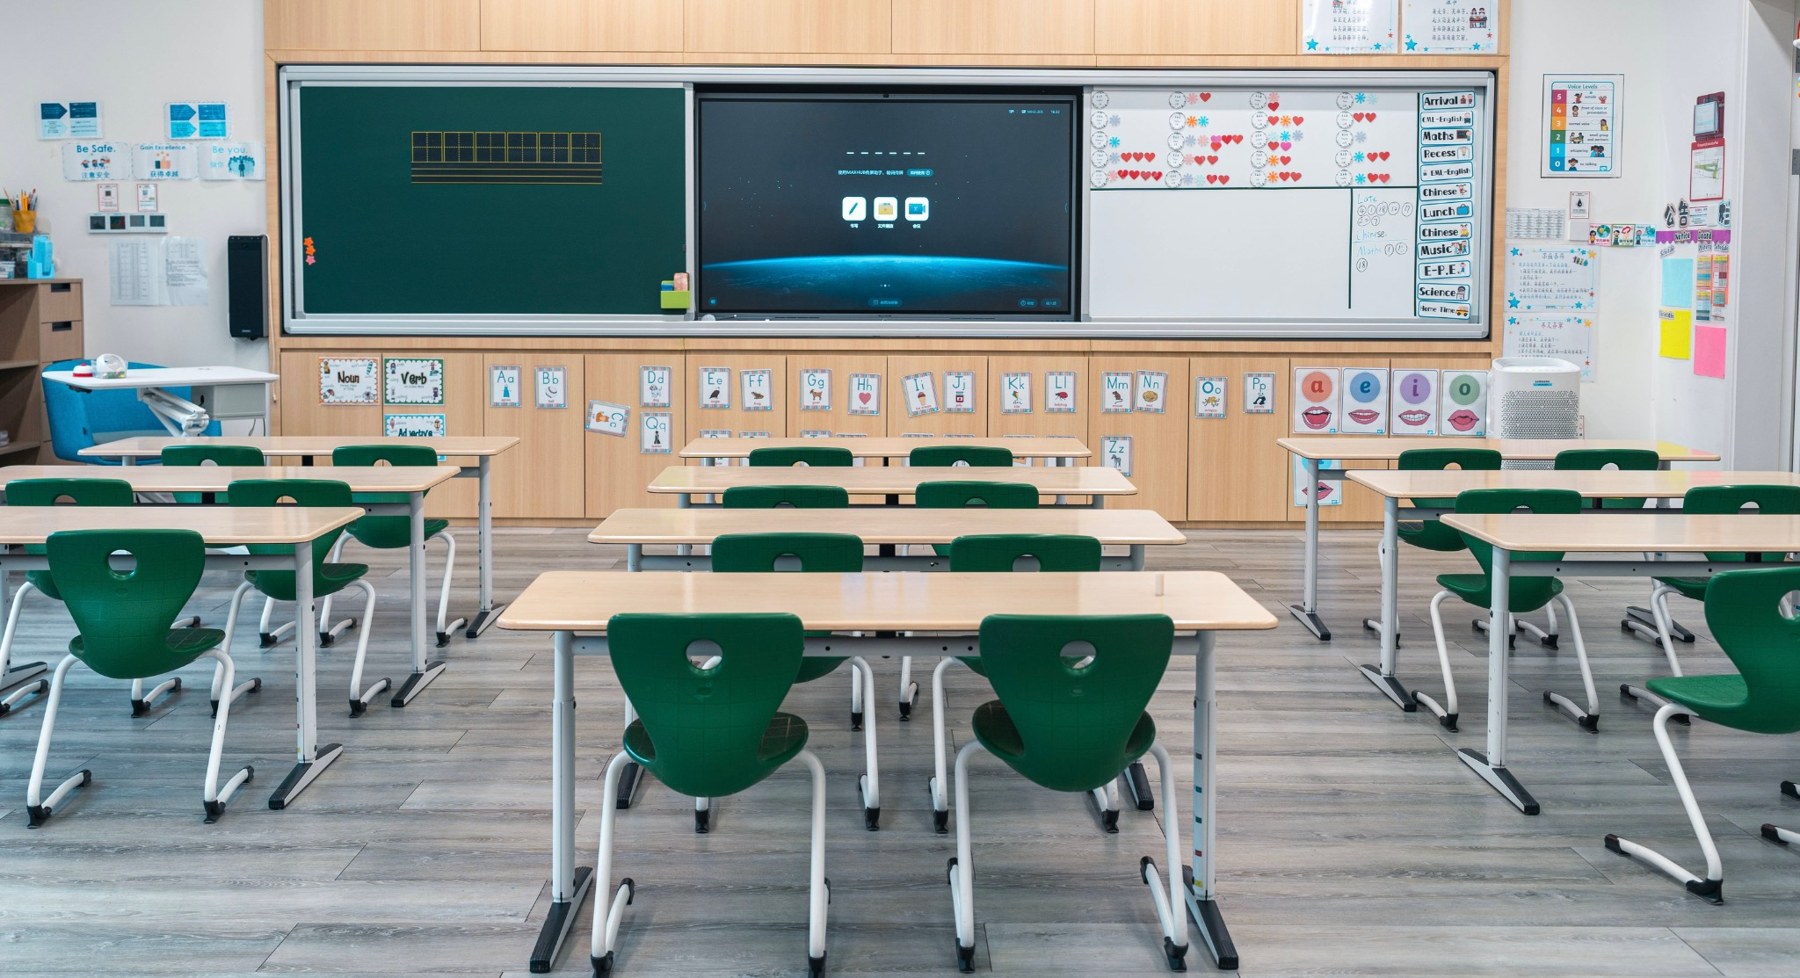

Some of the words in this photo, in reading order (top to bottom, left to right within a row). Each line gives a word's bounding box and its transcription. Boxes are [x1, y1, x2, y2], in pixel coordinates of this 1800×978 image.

[1424, 96, 1458, 106] Arrival
[1423, 132, 1454, 140] Maths
[92, 144, 116, 153] Safe.
[1424, 150, 1456, 158] Recess
[1423, 188, 1457, 197] Chinese
[1424, 207, 1455, 218] Lunch
[1422, 228, 1458, 237] Chinese
[1420, 244, 1452, 256] Music
[1424, 264, 1460, 276] E-P.E.
[1420, 287, 1456, 297] Science
[338, 371, 360, 383] Noun
[401, 372, 427, 384] Verb
[1311, 379, 1324, 393] a
[1360, 380, 1371, 393] e
[1412, 379, 1419, 397] i
[1459, 383, 1471, 395] o
